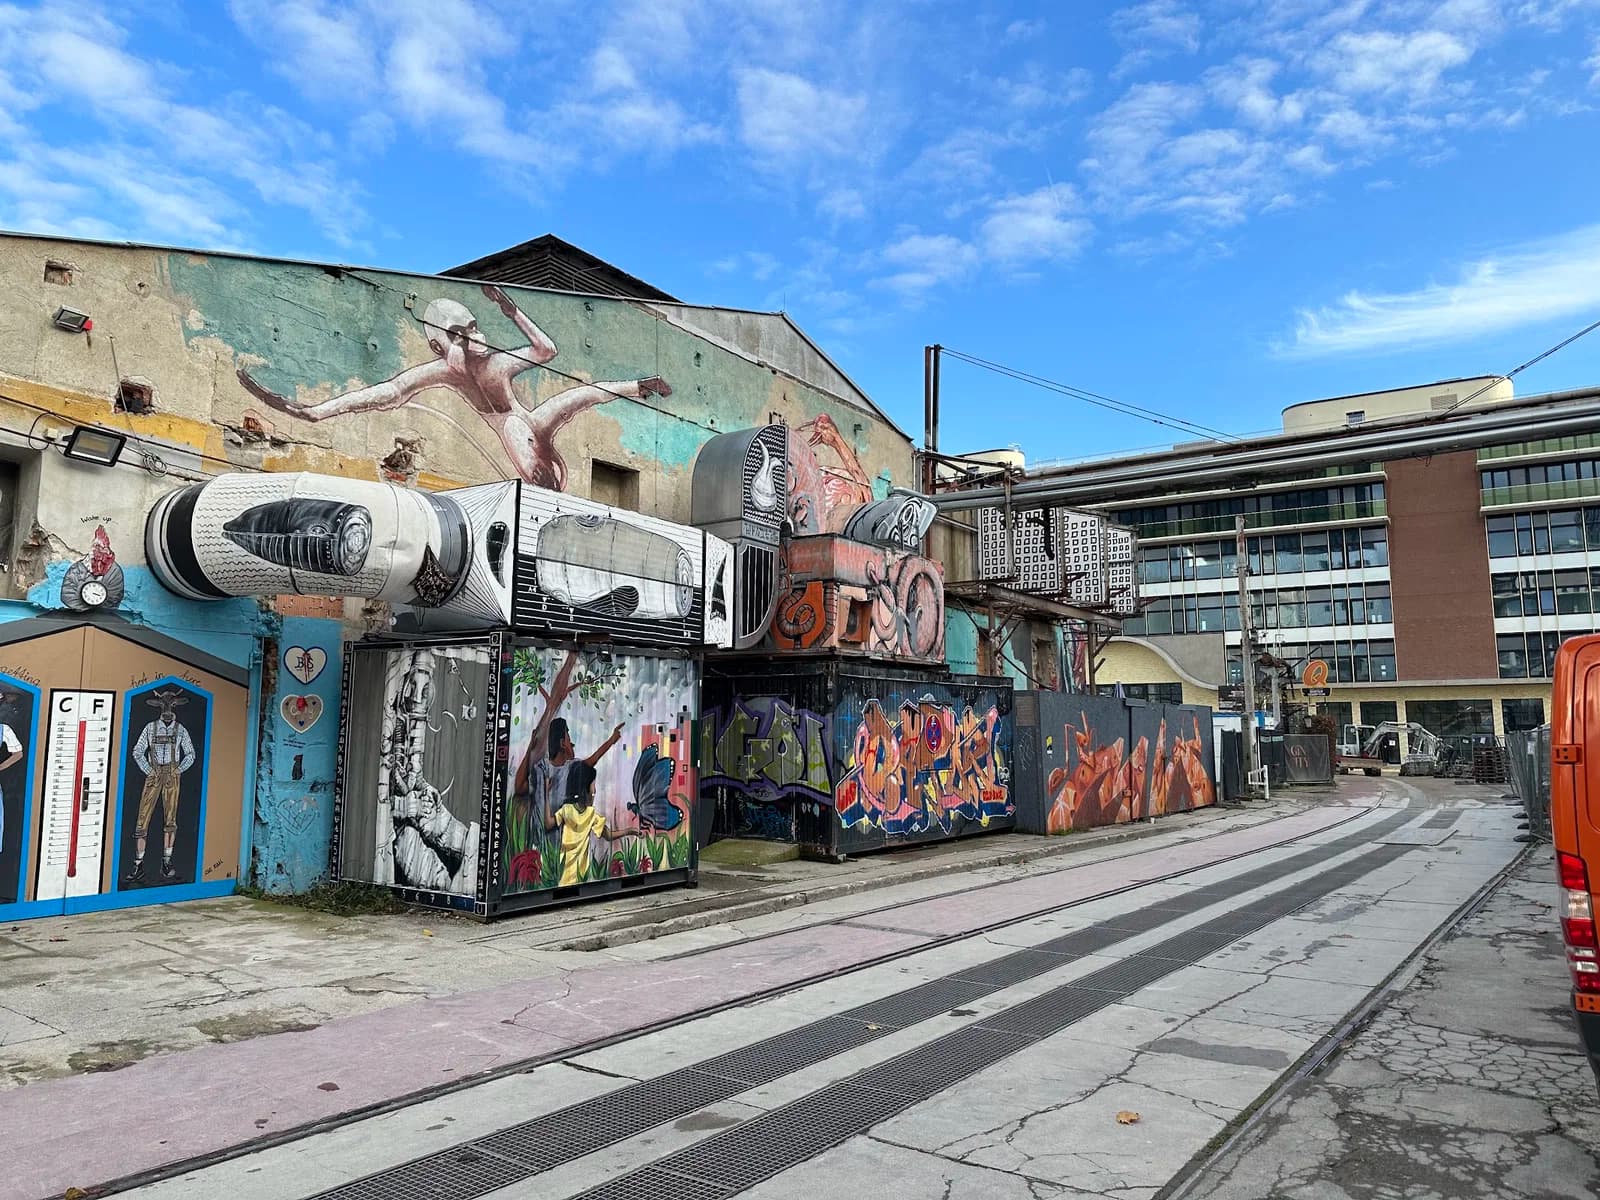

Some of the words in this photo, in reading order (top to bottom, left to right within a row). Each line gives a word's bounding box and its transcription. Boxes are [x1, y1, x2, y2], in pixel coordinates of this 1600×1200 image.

[1303, 660, 1328, 687] Q
[59, 697, 73, 713] C
[92, 698, 105, 715] F
[494, 772, 502, 849] ALEXANDRE
